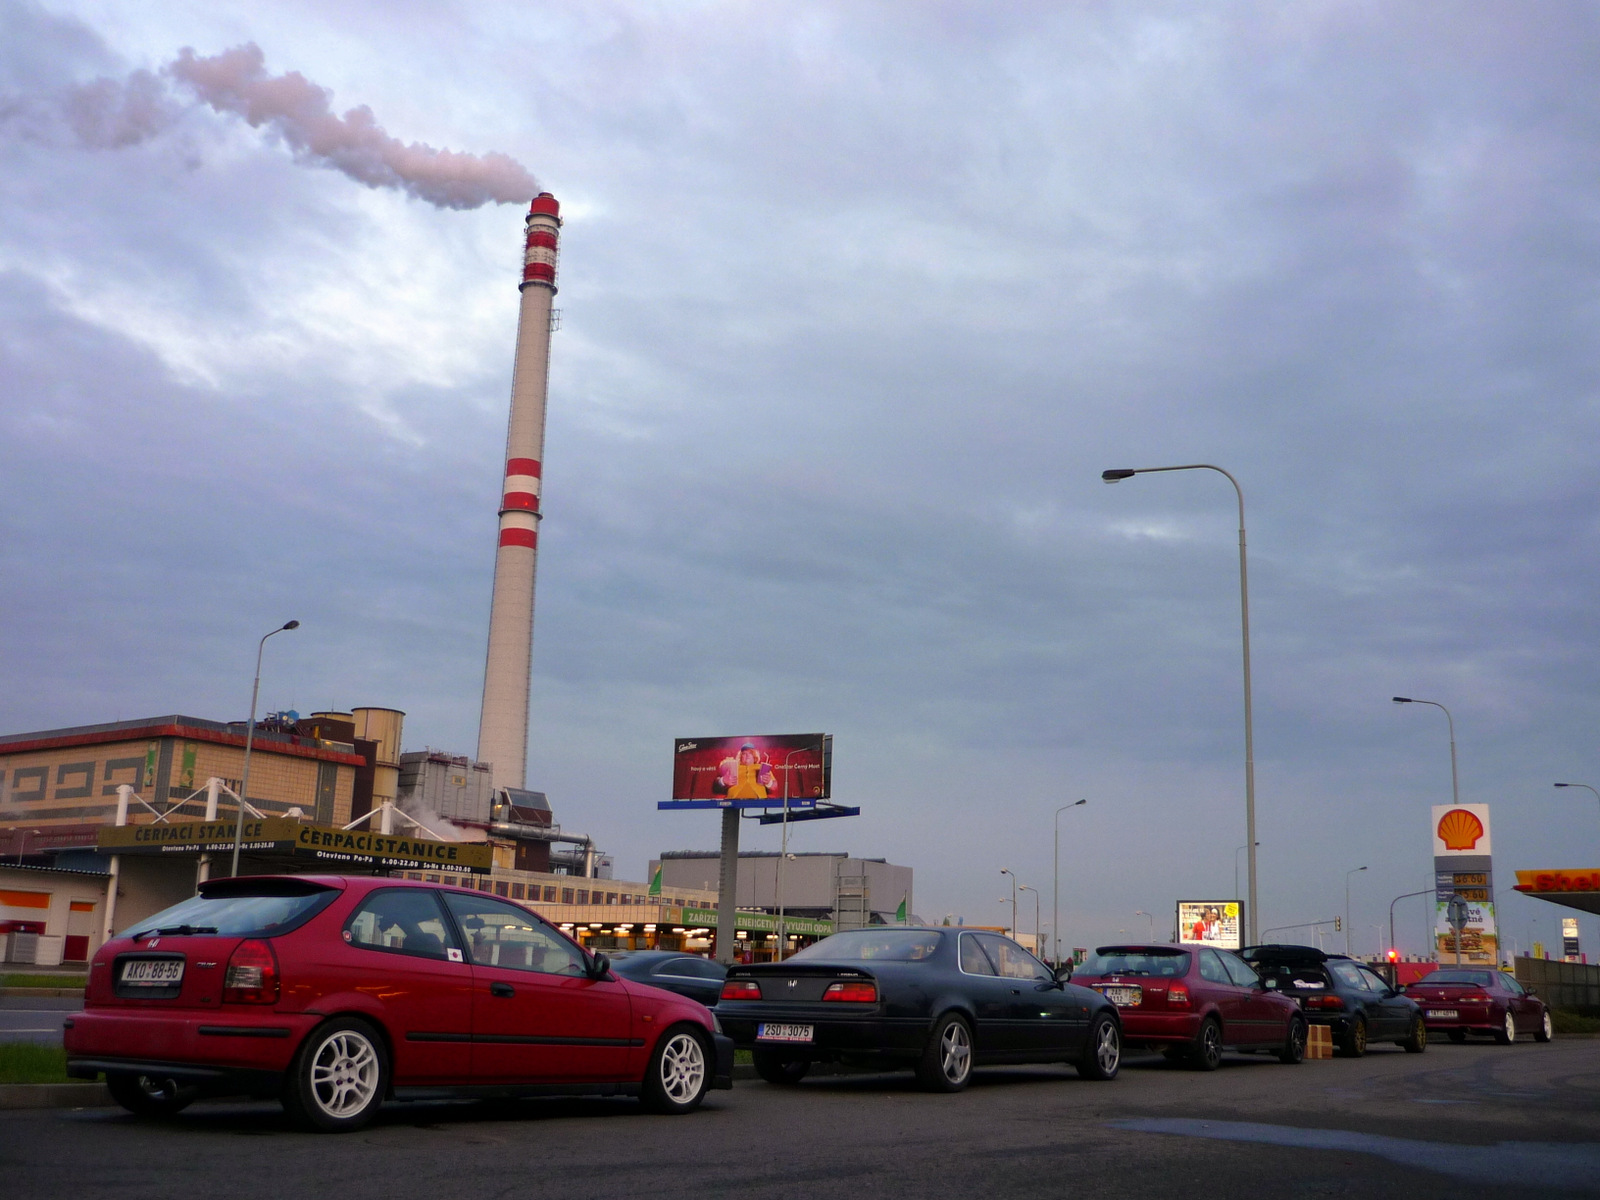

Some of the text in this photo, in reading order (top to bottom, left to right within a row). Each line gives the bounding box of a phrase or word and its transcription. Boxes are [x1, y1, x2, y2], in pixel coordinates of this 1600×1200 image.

[135, 823, 263, 842] ČERPACÍ STANCE
[299, 826, 459, 861] ČERPACÍ STANICE
[316, 850, 351, 861] Otevřeno
[382, 858, 419, 868] 6.00-22.00
[688, 911, 718, 925] ZAŘÍZE
[813, 925, 834, 934] ODPA
[126, 962, 180, 979] AKO 88-56
[764, 1024, 810, 1037] 2SD 3075
